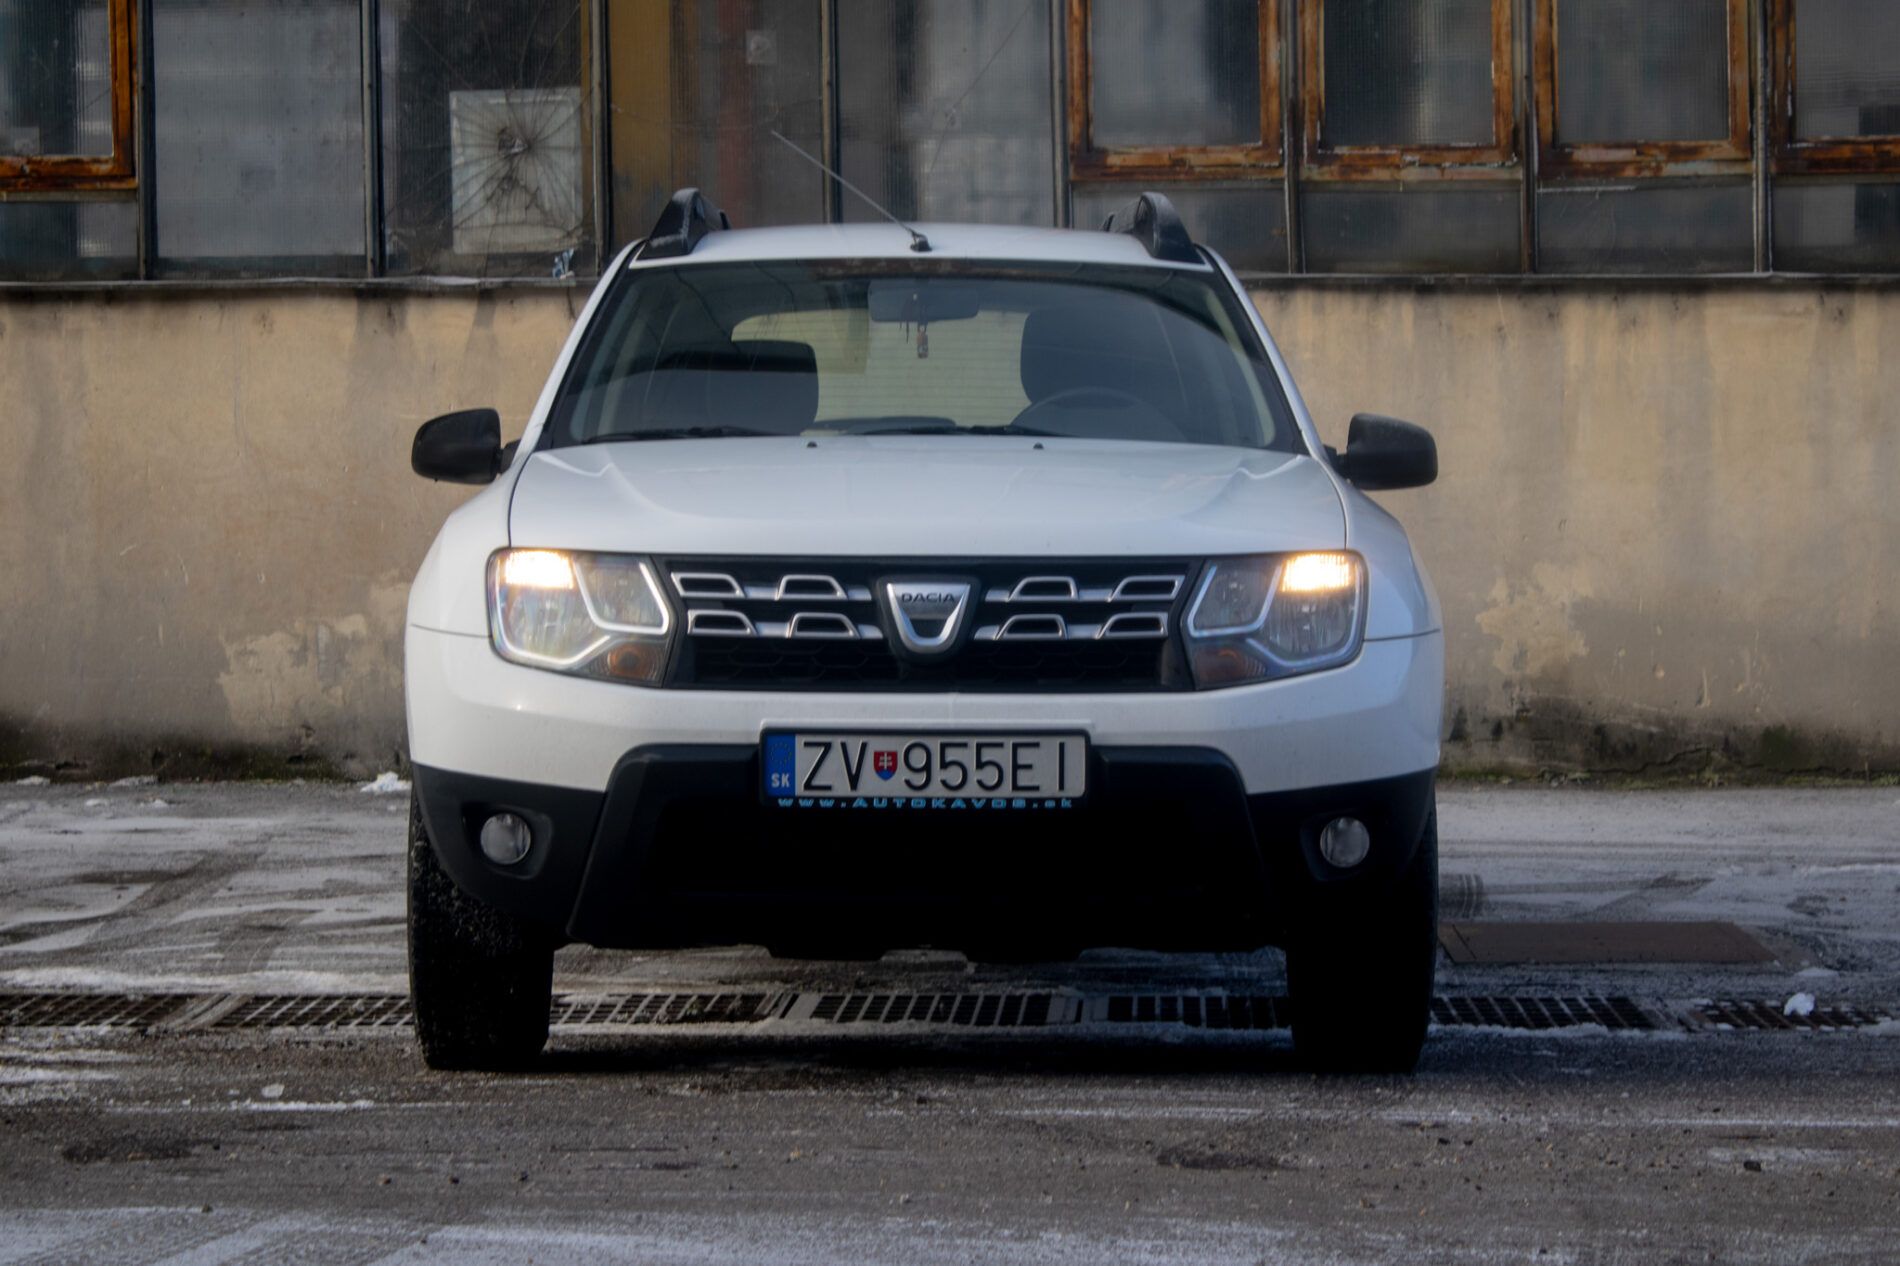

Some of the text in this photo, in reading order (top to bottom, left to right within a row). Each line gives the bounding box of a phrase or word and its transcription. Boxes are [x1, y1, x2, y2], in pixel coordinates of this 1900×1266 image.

[902, 592, 955, 602] DACIA
[803, 741, 868, 791] ZV
[771, 774, 790, 788] SK
